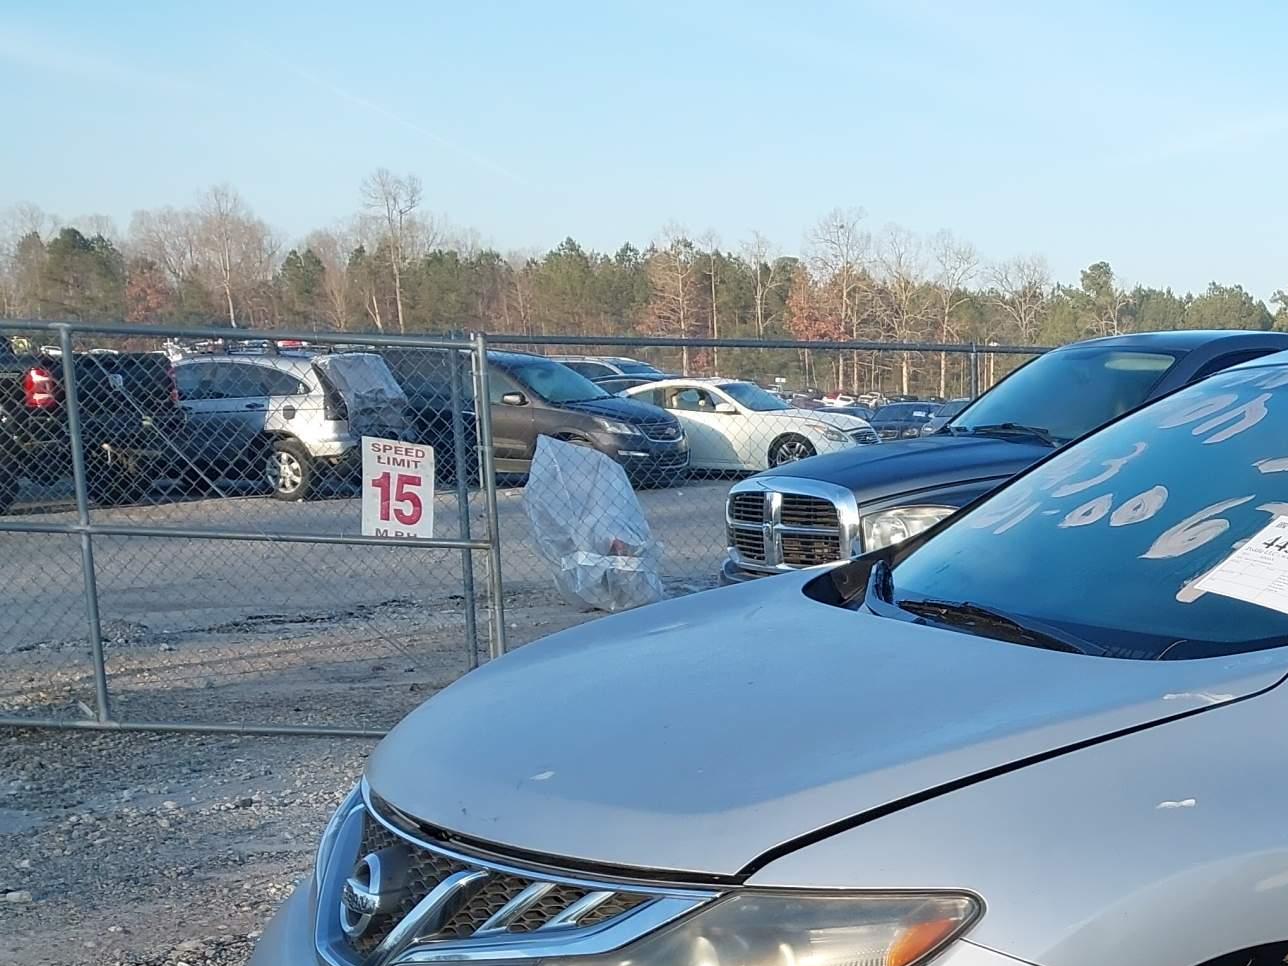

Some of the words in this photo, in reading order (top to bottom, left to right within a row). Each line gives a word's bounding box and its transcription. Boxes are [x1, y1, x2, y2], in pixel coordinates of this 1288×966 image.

[371, 442, 426, 459] SPEED
[377, 455, 421, 469] LIMIT
[371, 471, 423, 526] 15
